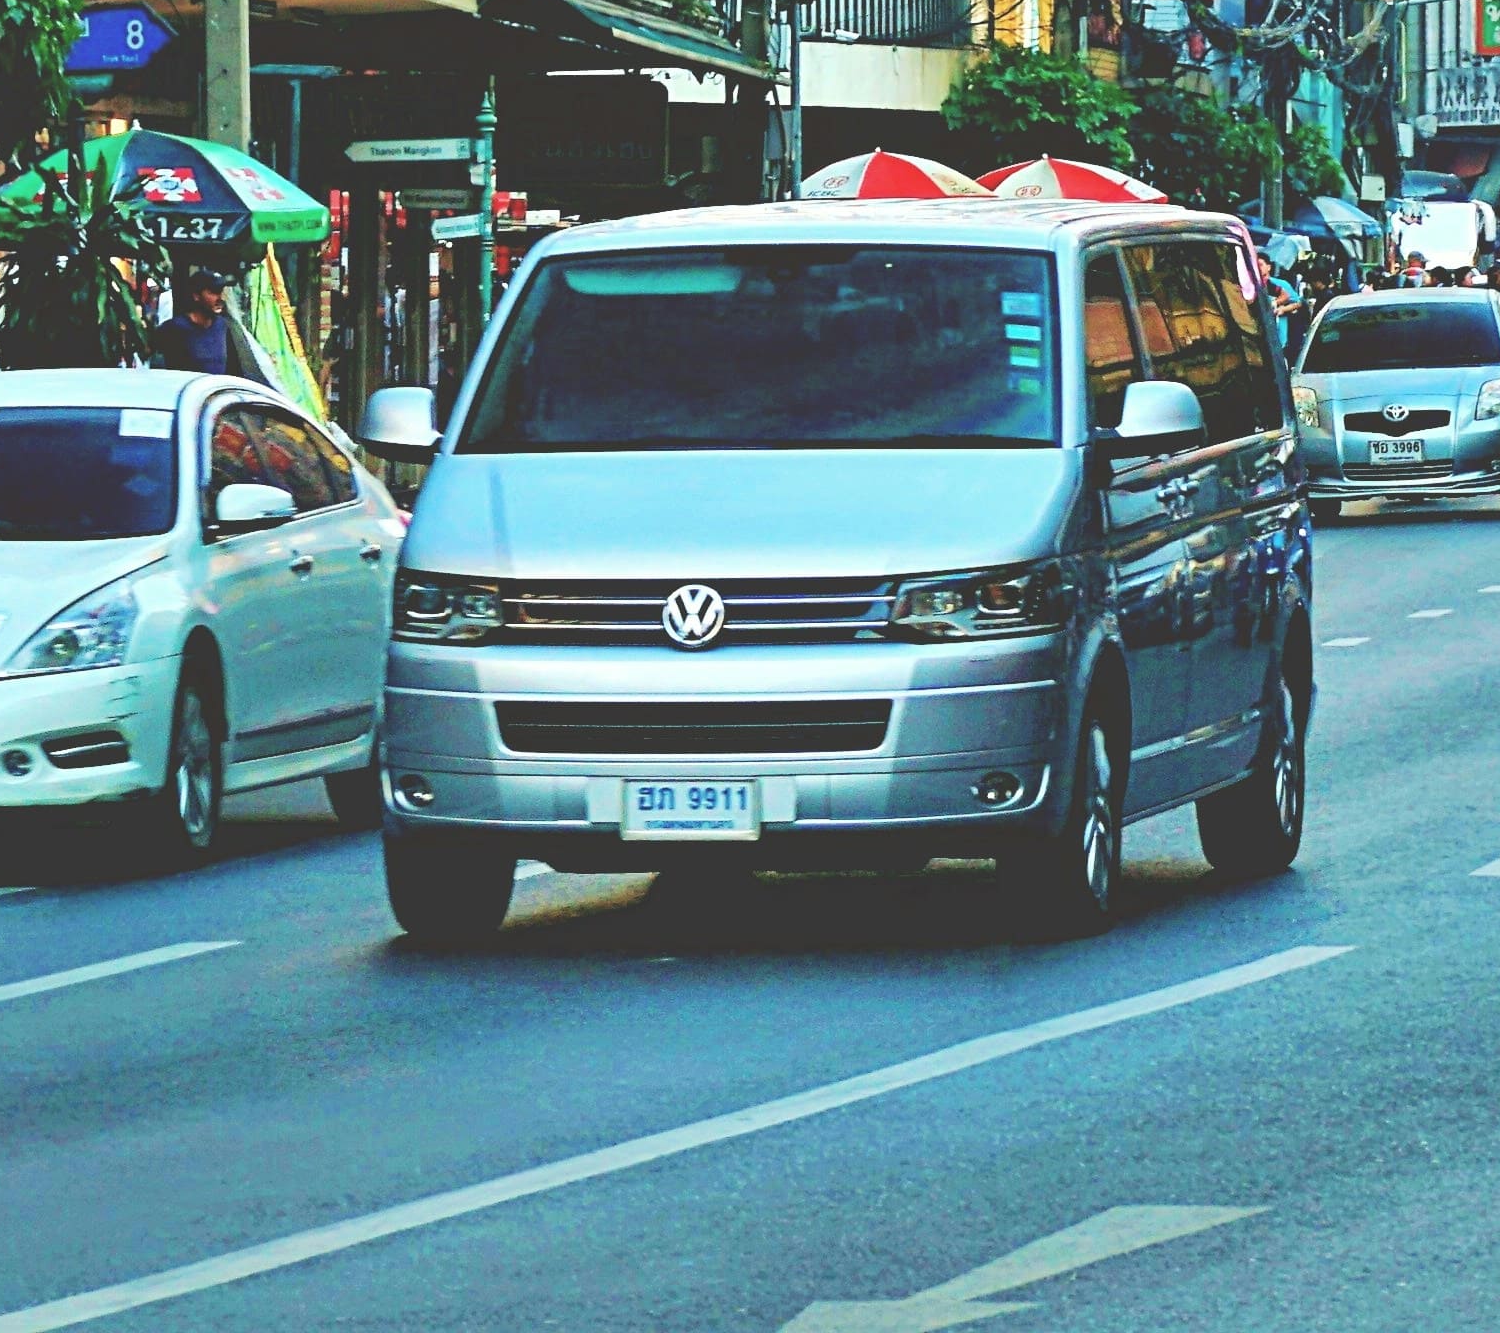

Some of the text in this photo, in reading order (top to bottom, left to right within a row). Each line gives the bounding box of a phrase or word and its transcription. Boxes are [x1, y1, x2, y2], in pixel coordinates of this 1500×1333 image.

[126, 18, 144, 51] 8
[370, 144, 400, 157] Thanon
[687, 786, 748, 811] 9911
